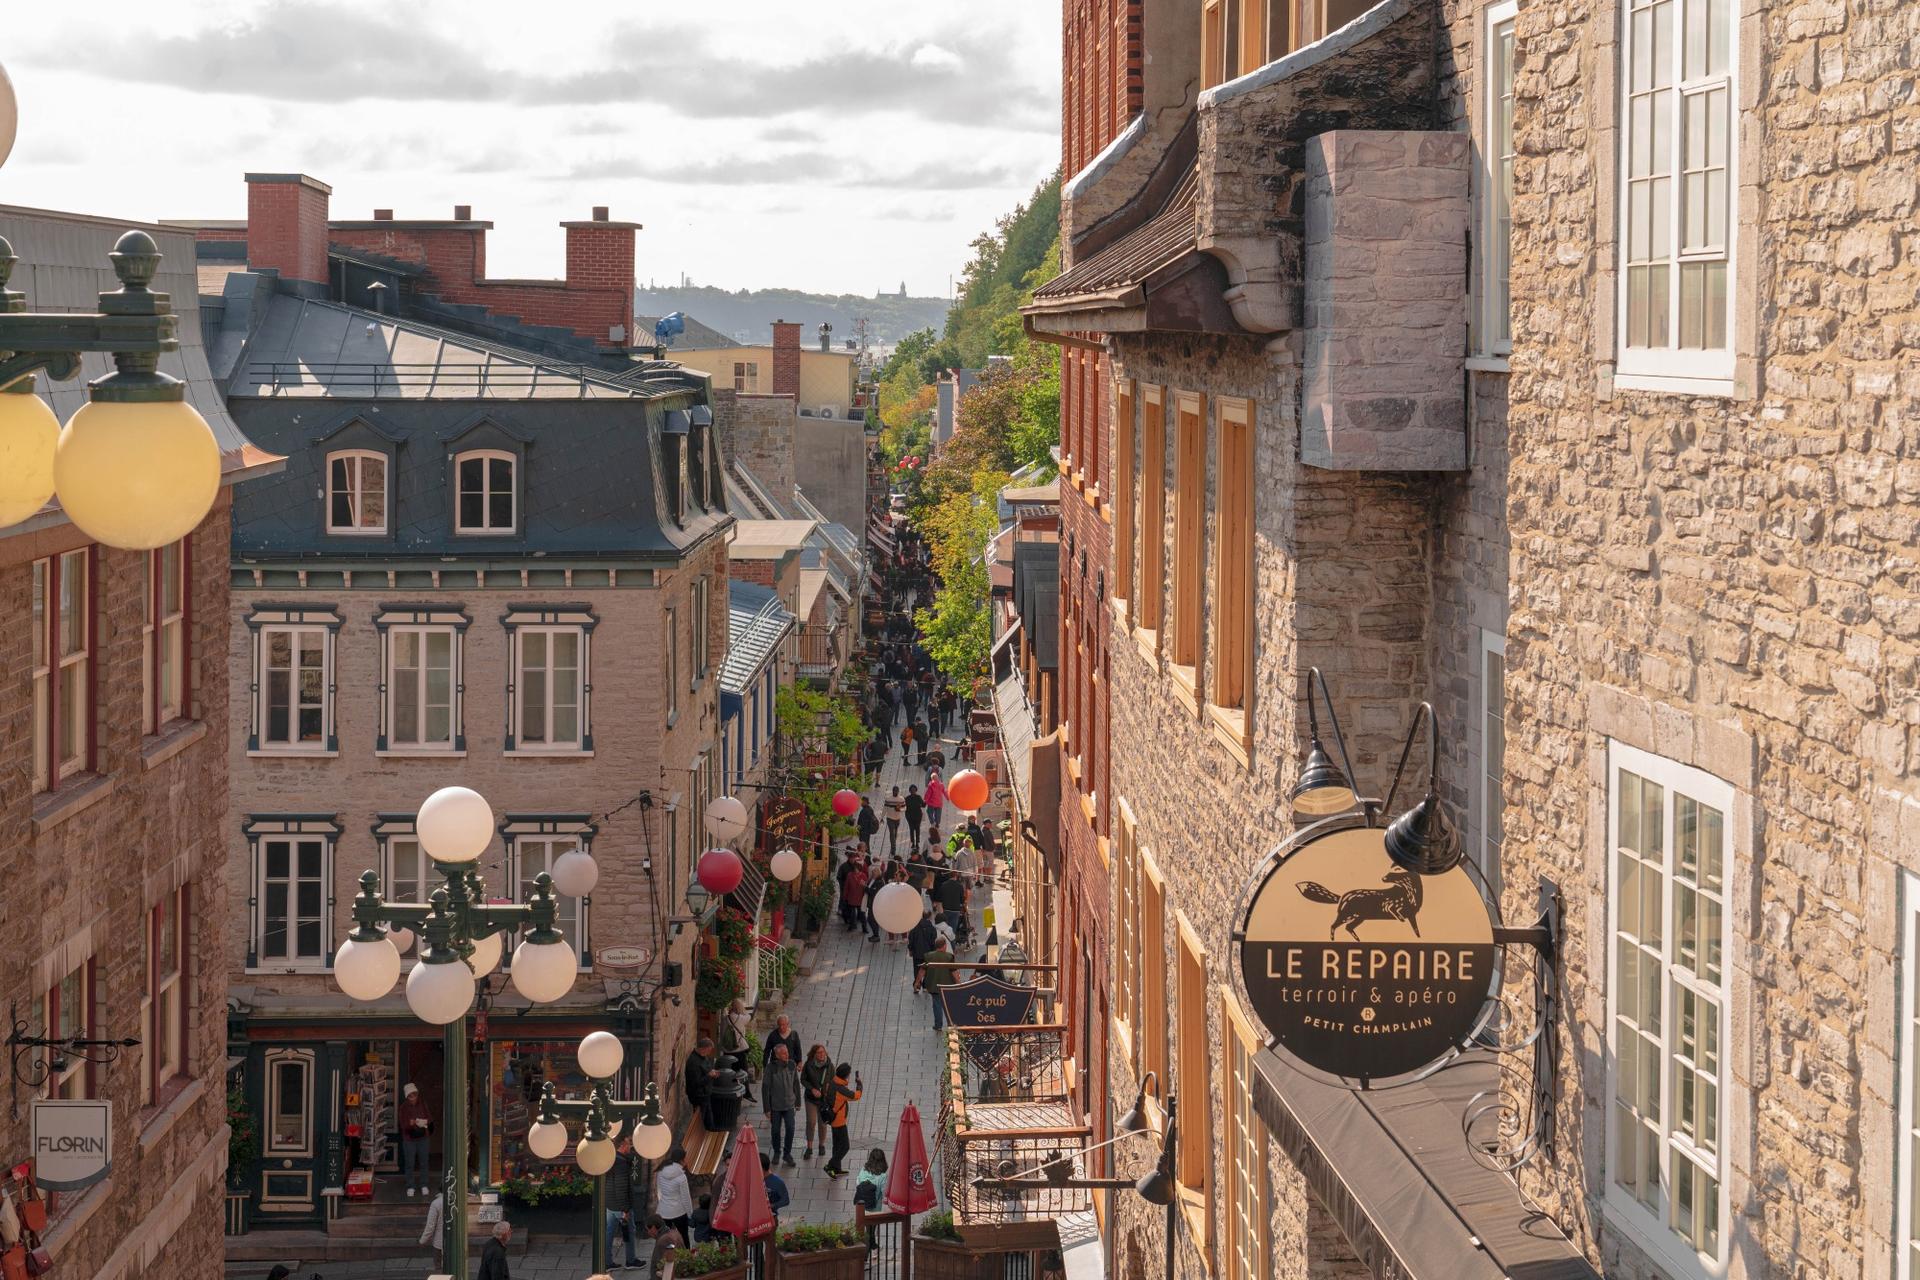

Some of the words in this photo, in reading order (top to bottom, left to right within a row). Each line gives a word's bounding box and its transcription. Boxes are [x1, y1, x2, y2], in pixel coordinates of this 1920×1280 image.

[1267, 949, 1302, 979] LE
[1322, 949, 1474, 980] REPAIRE
[966, 994, 982, 1006] Le
[985, 994, 1007, 1008] pub
[1281, 985, 1357, 1002] terroir
[1370, 986, 1381, 1003] &
[1395, 986, 1456, 1007] apéro
[976, 1010, 996, 1023] des
[1304, 1015, 1345, 1032] PETIT
[1352, 1016, 1433, 1034] CHAMPLAIN
[38, 1136, 104, 1152] FLORIN
